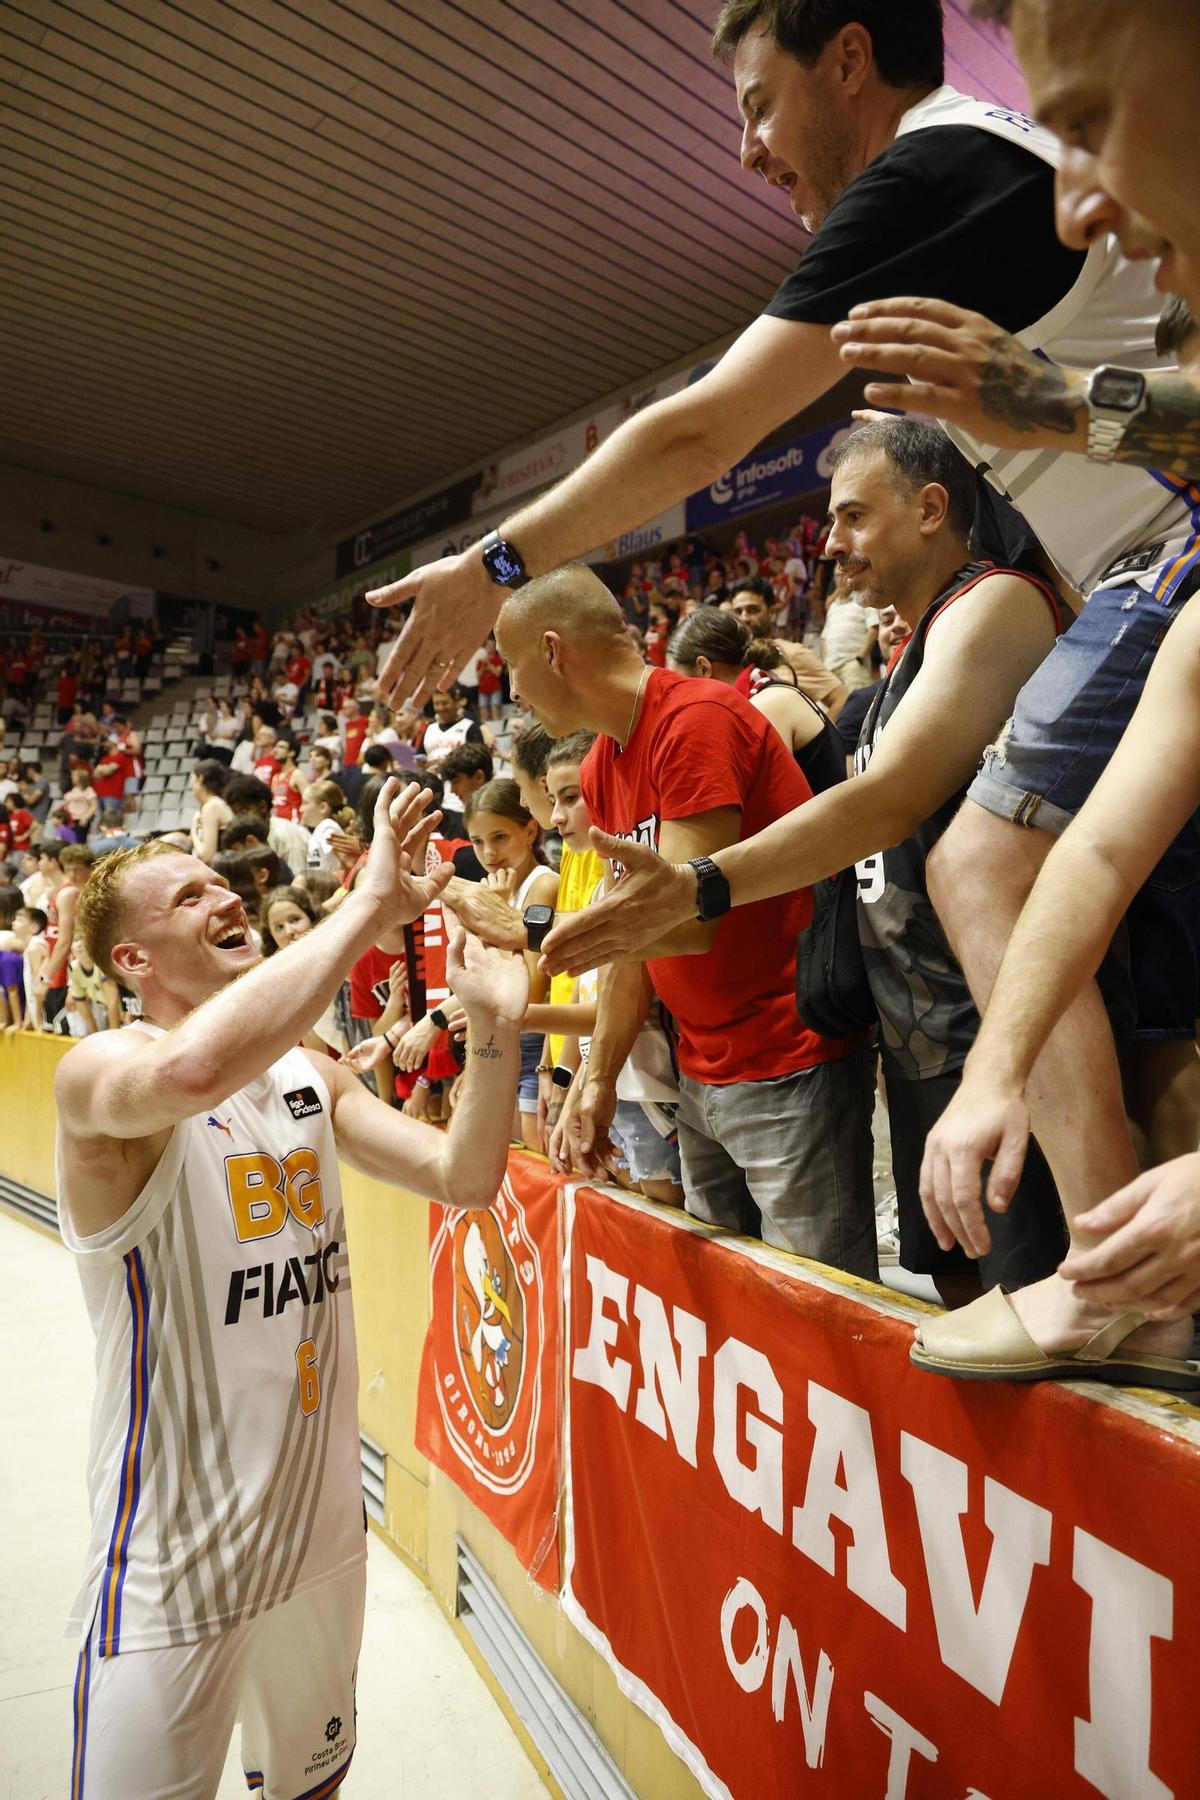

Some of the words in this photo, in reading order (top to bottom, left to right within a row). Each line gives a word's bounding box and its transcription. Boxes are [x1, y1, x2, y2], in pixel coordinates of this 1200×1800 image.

[736, 448, 804, 487] infosoft
[293, 1103, 321, 1116] endesa
[224, 1147, 324, 1243] BG
[224, 1241, 340, 1326] FIATC
[295, 1338, 322, 1418] 6
[573, 1253, 1174, 1800] ENGAVI
[720, 1576, 835, 1769] ON
[304, 1758, 330, 1776] Pirineu
[312, 1747, 333, 1762] Costa
